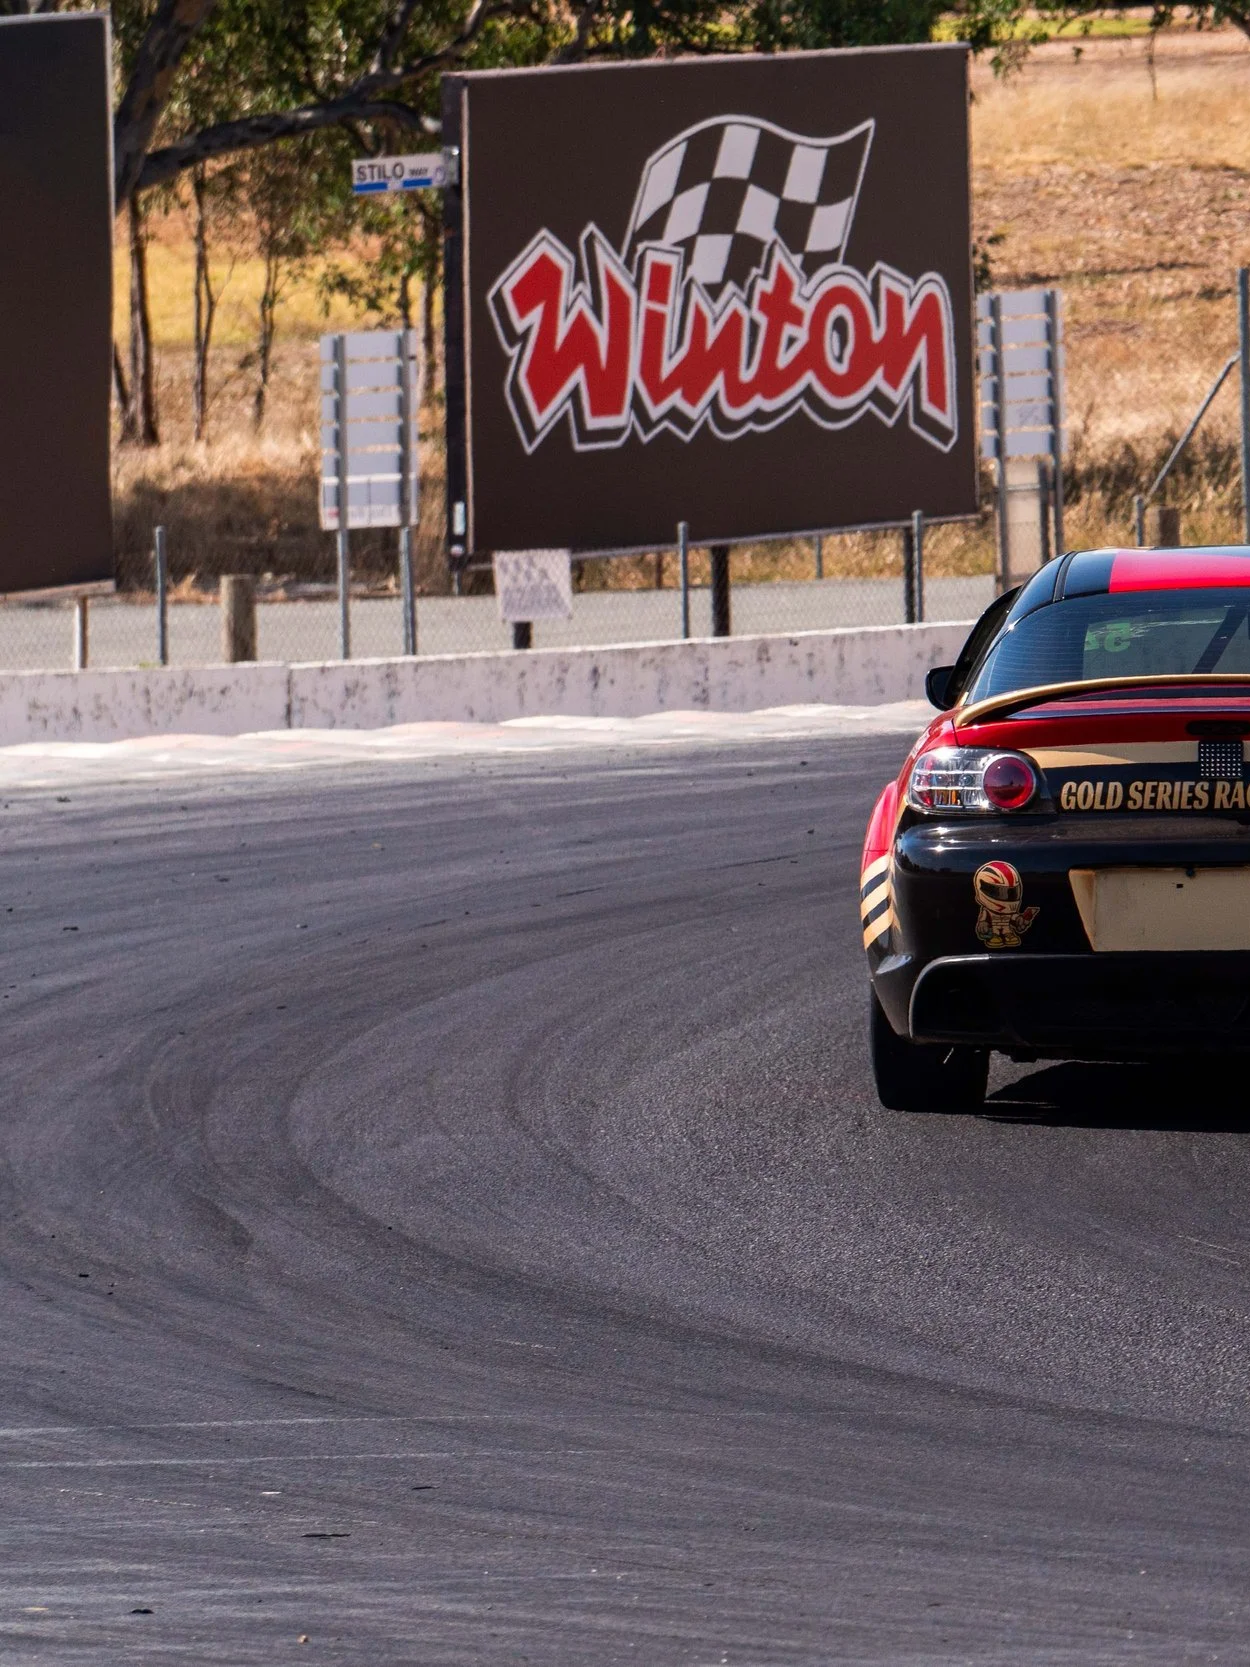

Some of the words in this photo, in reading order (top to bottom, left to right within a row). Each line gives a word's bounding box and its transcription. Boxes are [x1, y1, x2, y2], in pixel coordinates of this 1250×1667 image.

[357, 162, 405, 181] STILO
[491, 226, 955, 450] Winton
[1060, 781, 1124, 810] GOLD
[1127, 780, 1210, 810] SERIES
